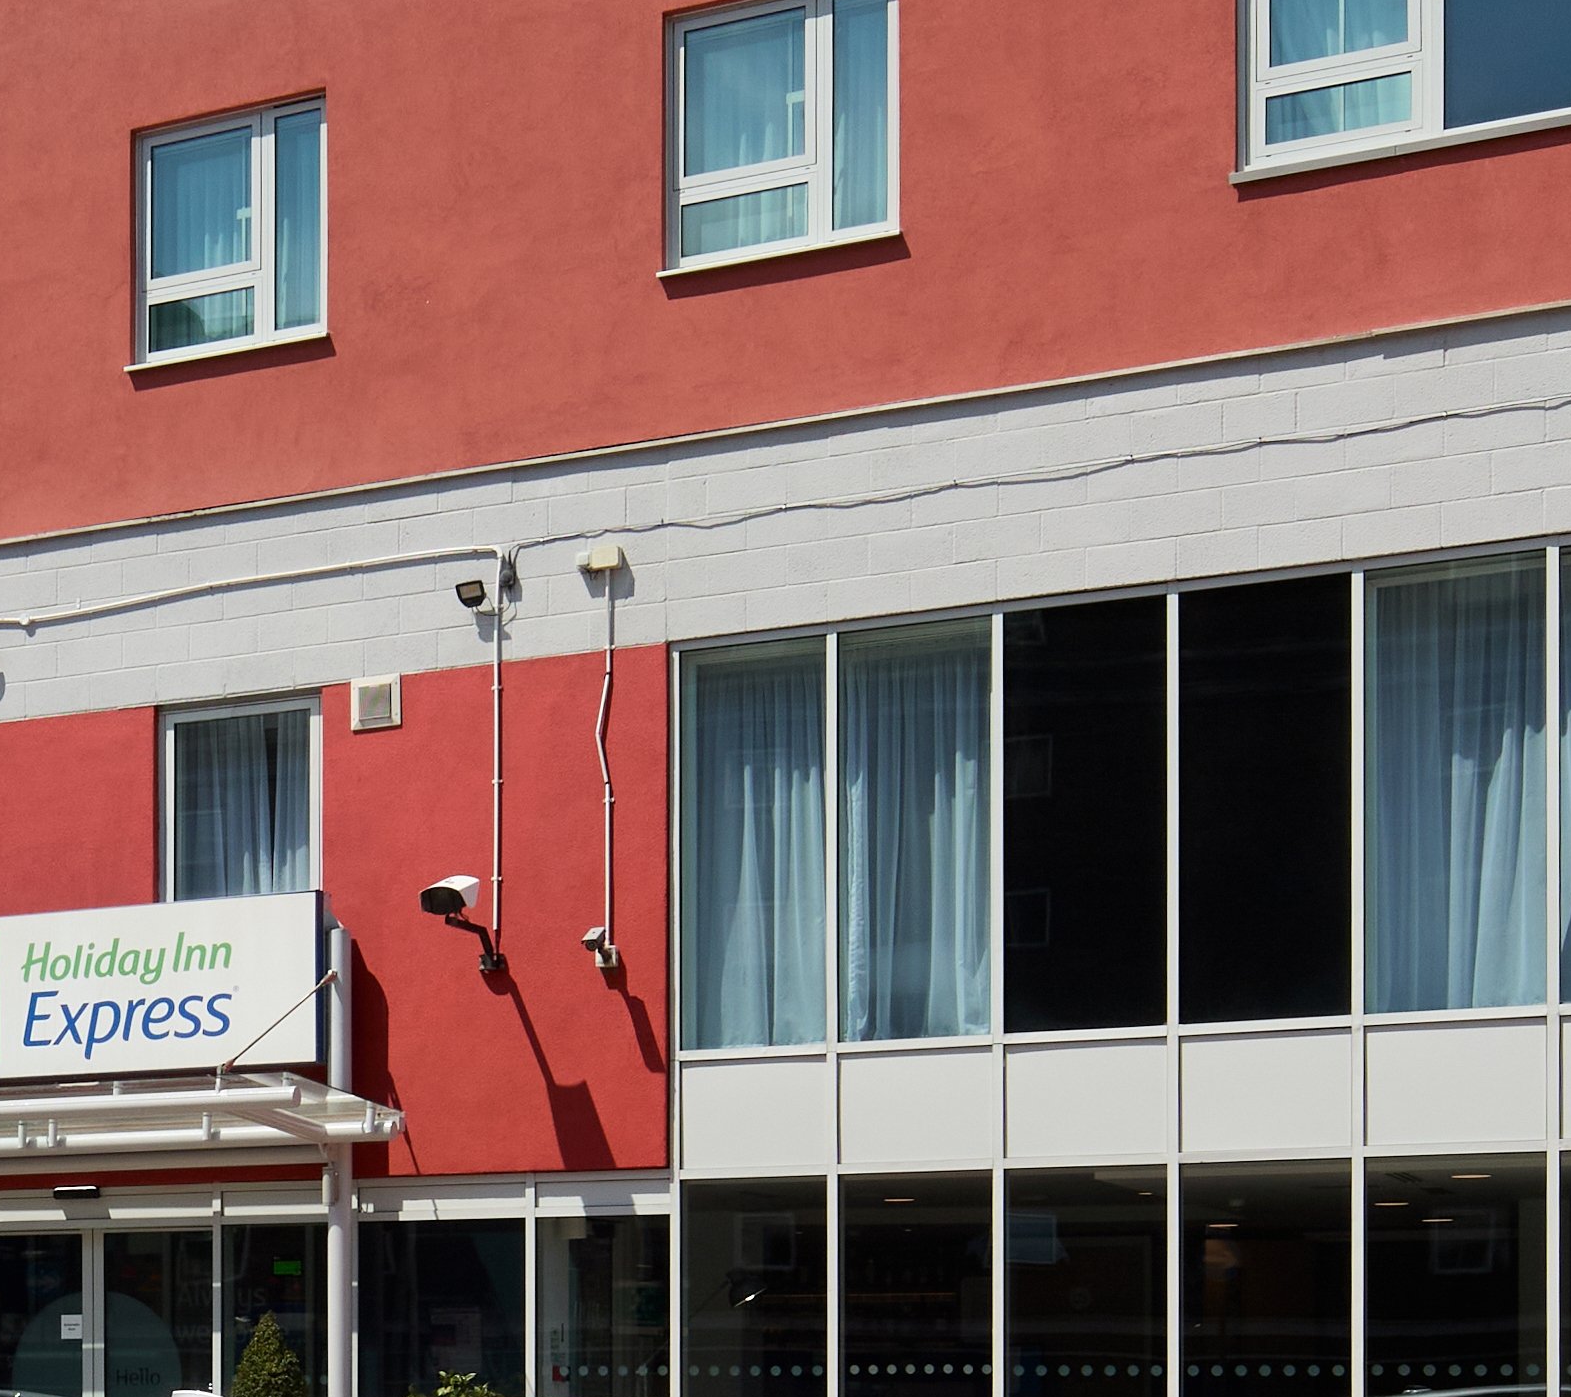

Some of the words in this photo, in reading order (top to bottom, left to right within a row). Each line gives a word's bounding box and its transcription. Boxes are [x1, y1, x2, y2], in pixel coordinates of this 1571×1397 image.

[21, 937, 166, 985] Holiday
[172, 931, 232, 973] Inn
[23, 990, 233, 1060] Express
[116, 1367, 160, 1386] Hello
